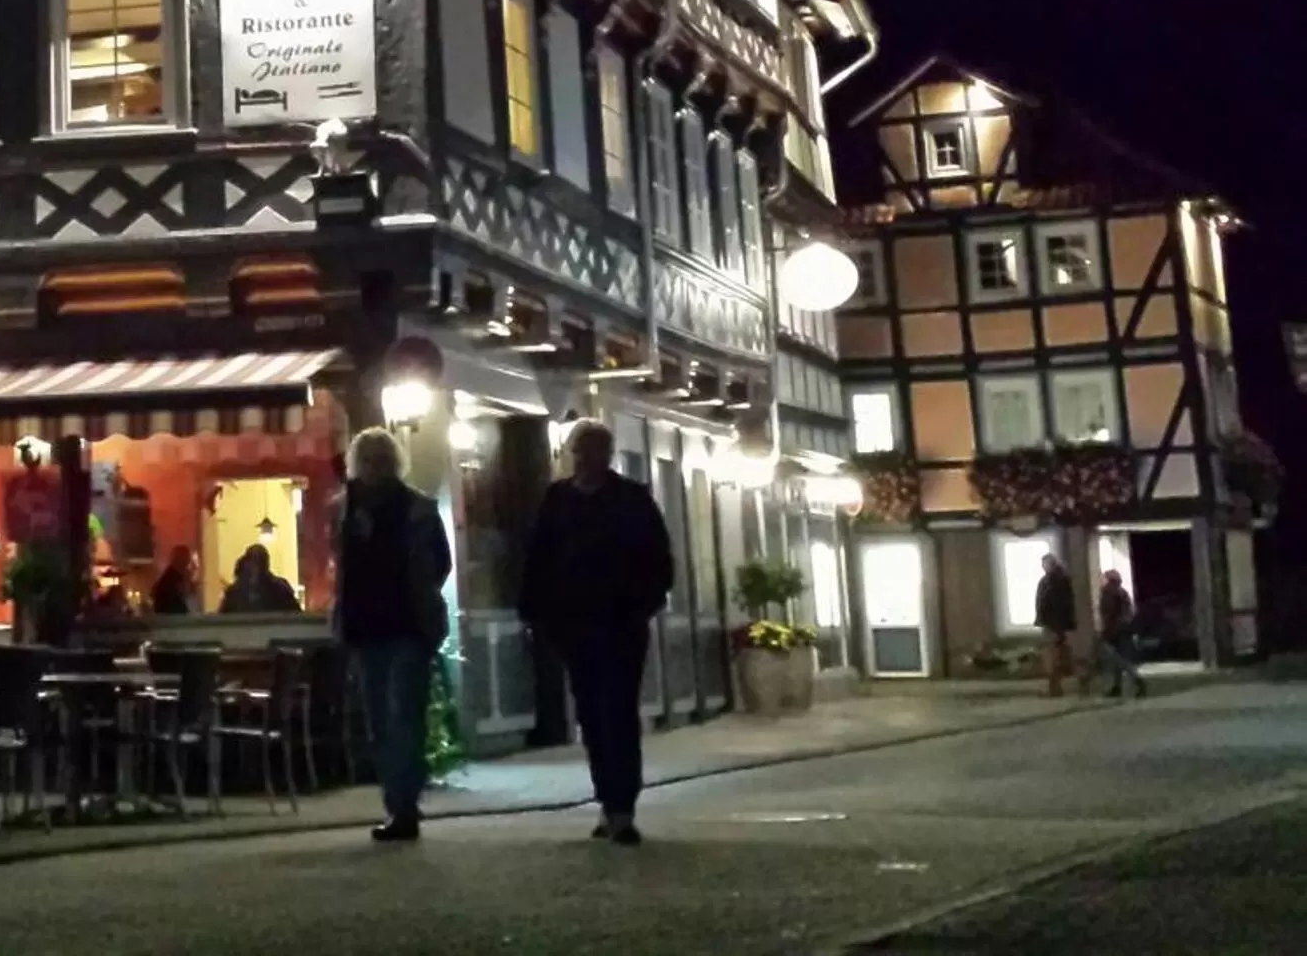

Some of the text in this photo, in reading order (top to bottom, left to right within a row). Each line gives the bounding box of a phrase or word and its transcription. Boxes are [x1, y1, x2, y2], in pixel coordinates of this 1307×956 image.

[241, 12, 354, 34] Ristorante
[247, 39, 343, 61] Originale
[251, 61, 341, 82] Italiano
